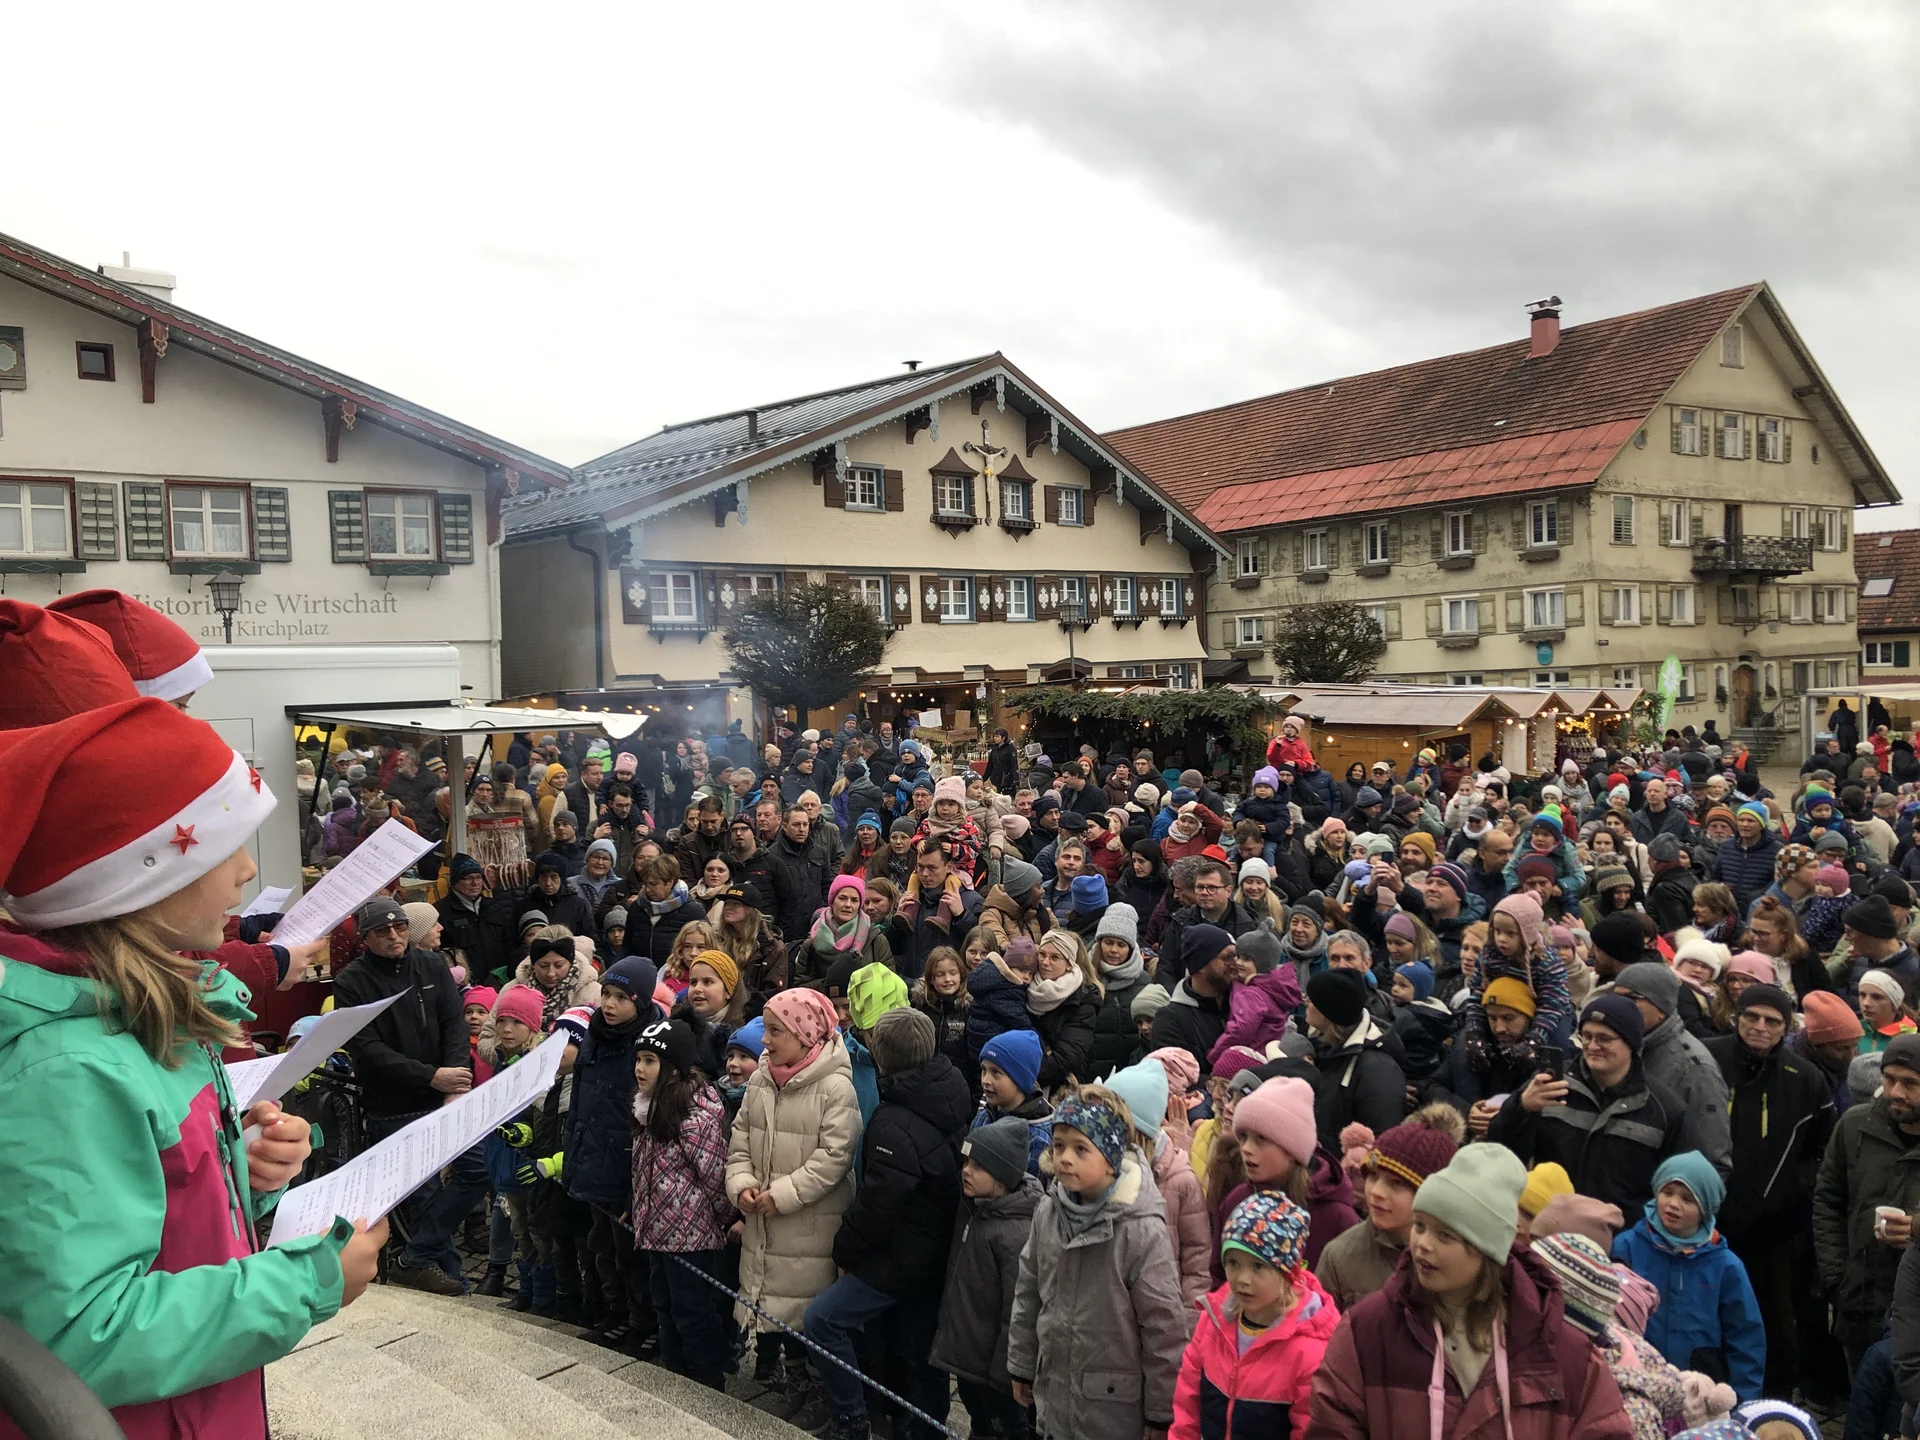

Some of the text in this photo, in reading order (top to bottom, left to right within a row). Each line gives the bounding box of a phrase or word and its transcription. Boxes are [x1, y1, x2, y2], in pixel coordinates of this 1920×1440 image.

[126, 592, 398, 616] istorihe Wirtschaft
[237, 619, 330, 640] Kirchplatz
